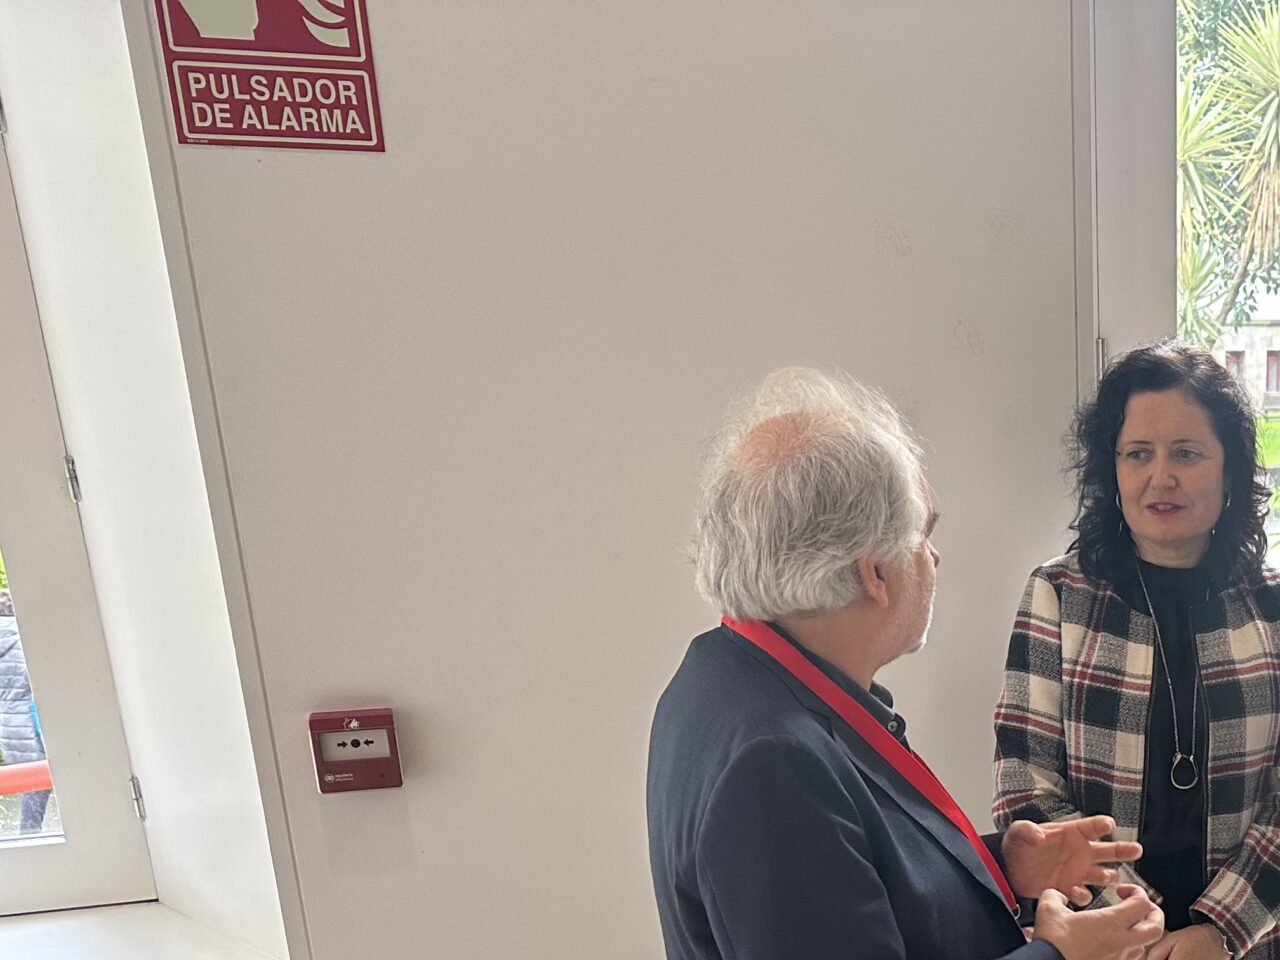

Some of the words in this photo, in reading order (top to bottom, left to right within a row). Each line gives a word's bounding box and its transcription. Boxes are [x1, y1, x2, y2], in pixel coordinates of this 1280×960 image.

[188, 72, 358, 105] PULSADOR
[192, 102, 234, 128] DE
[242, 104, 365, 133] ALARMA
